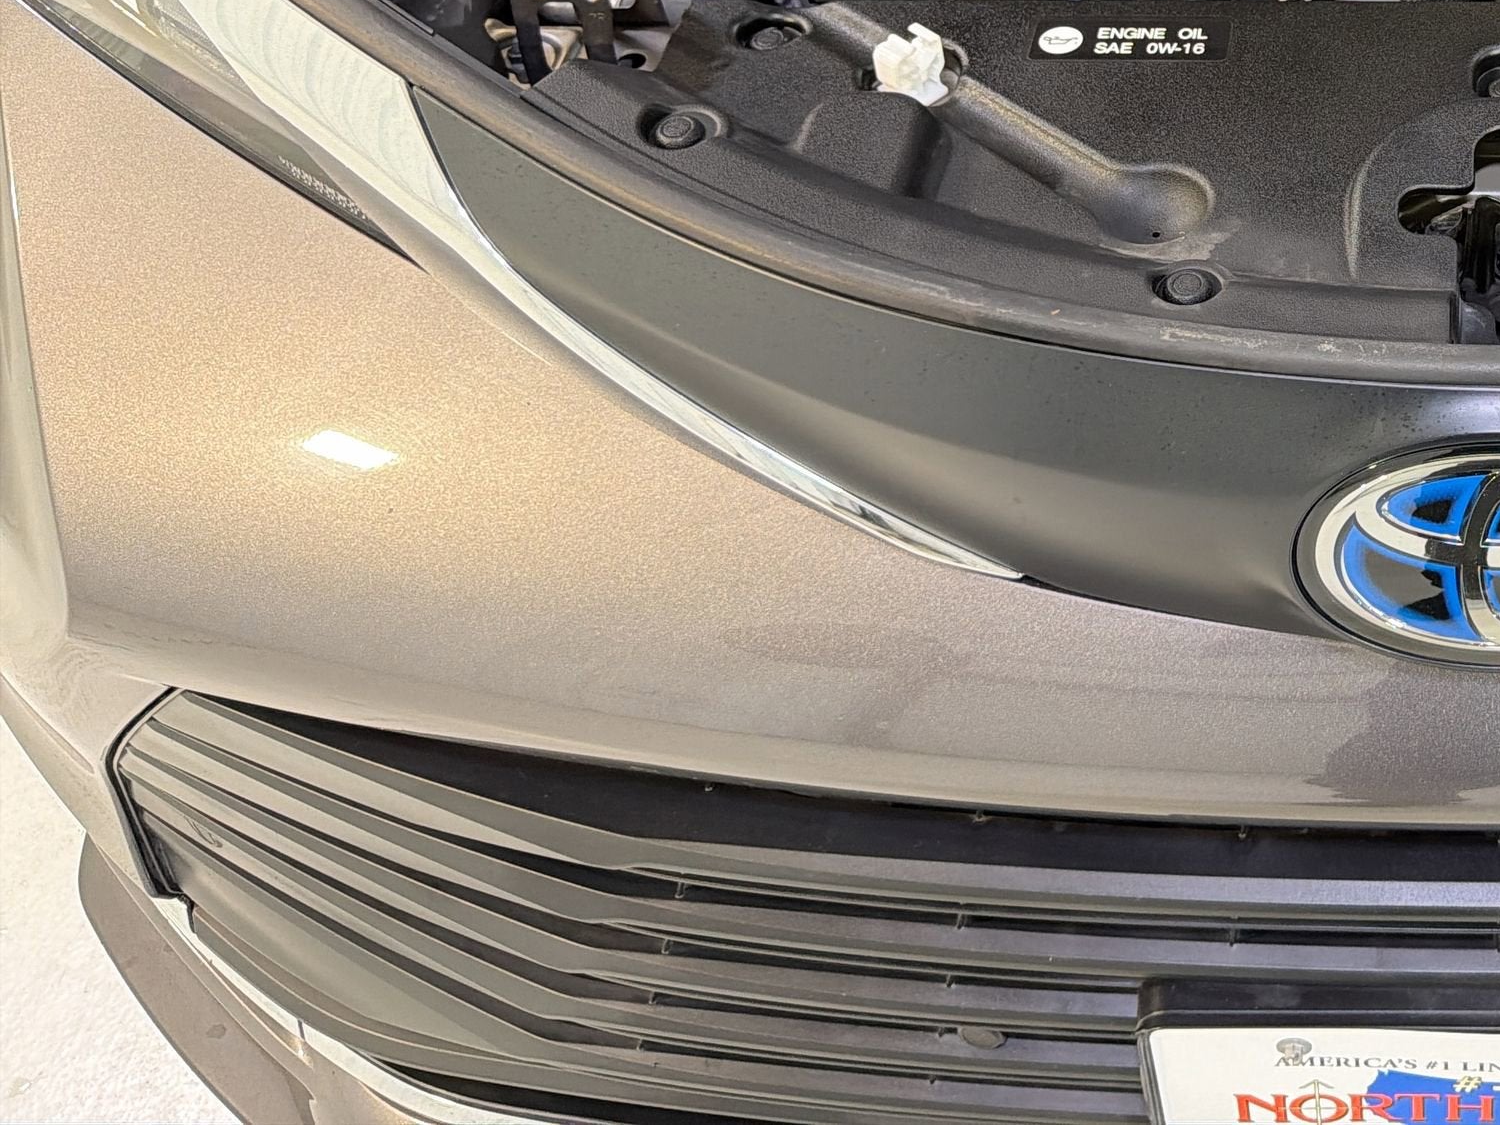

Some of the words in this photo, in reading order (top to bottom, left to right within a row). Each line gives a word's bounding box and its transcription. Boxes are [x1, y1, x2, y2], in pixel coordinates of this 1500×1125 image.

[1097, 27, 1166, 39] ENGINE
[1178, 27, 1208, 40] OIL
[1094, 42, 1134, 54] SAE
[1146, 42, 1205, 54] 0W-16
[1274, 1056, 1417, 1069] AMERICA'S
[1426, 1061, 1450, 1071] #1
[1233, 1093, 1495, 1123] NORTH
